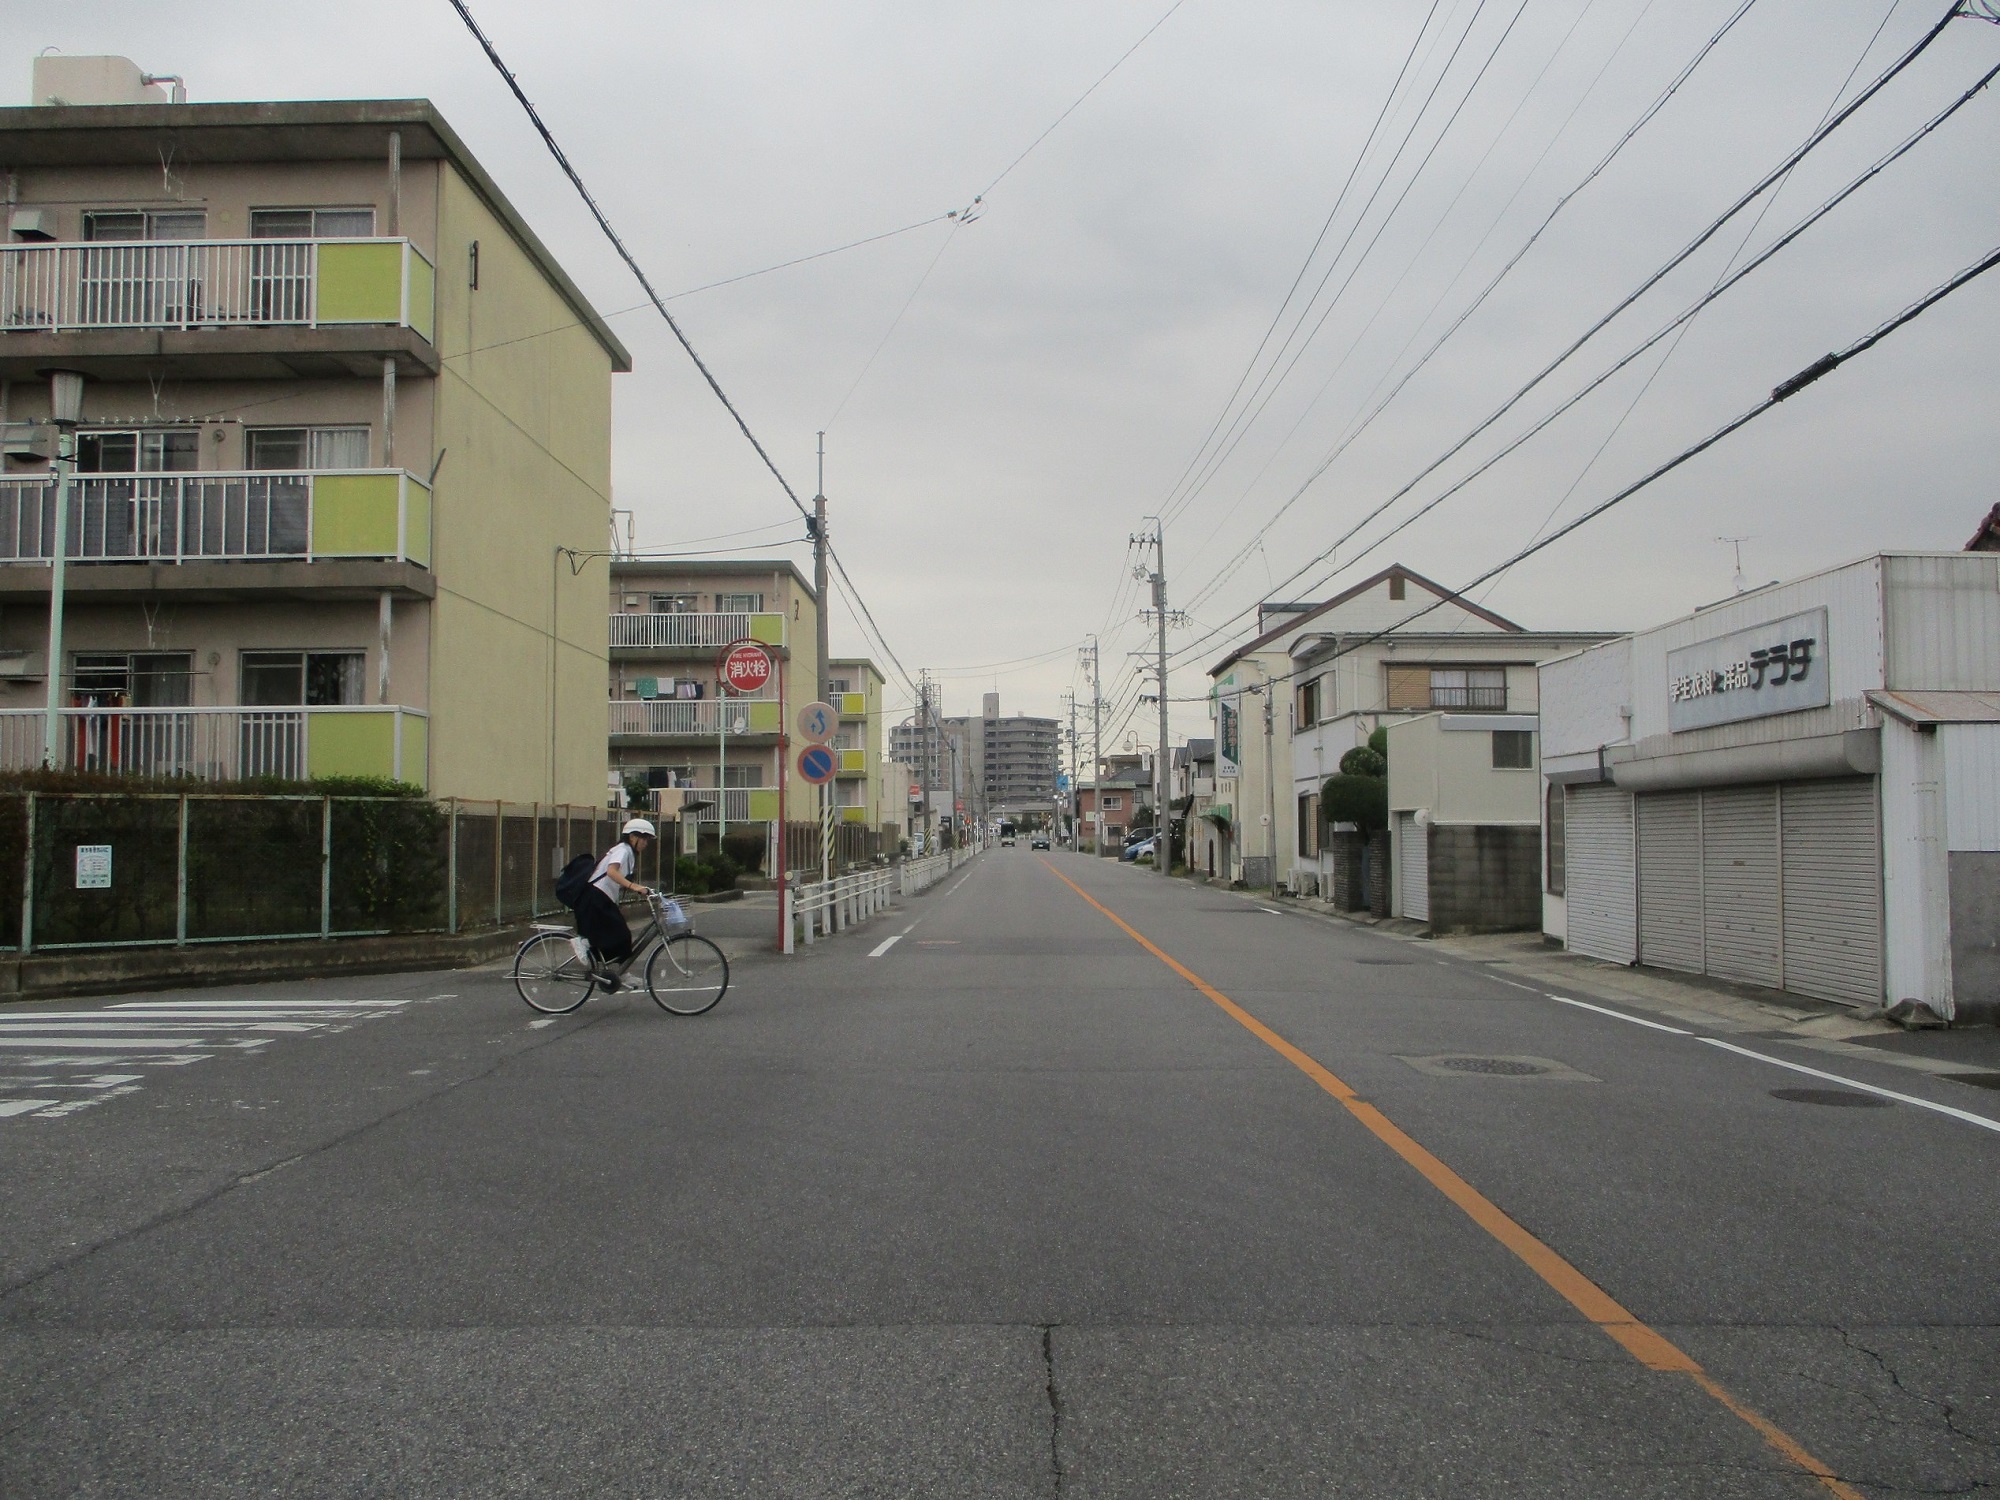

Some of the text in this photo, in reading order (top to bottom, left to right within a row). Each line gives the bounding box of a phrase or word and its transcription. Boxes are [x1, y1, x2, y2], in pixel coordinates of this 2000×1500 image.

[730, 660, 767, 678] 消火栓
[1750, 638, 1816, 690] テラダ
